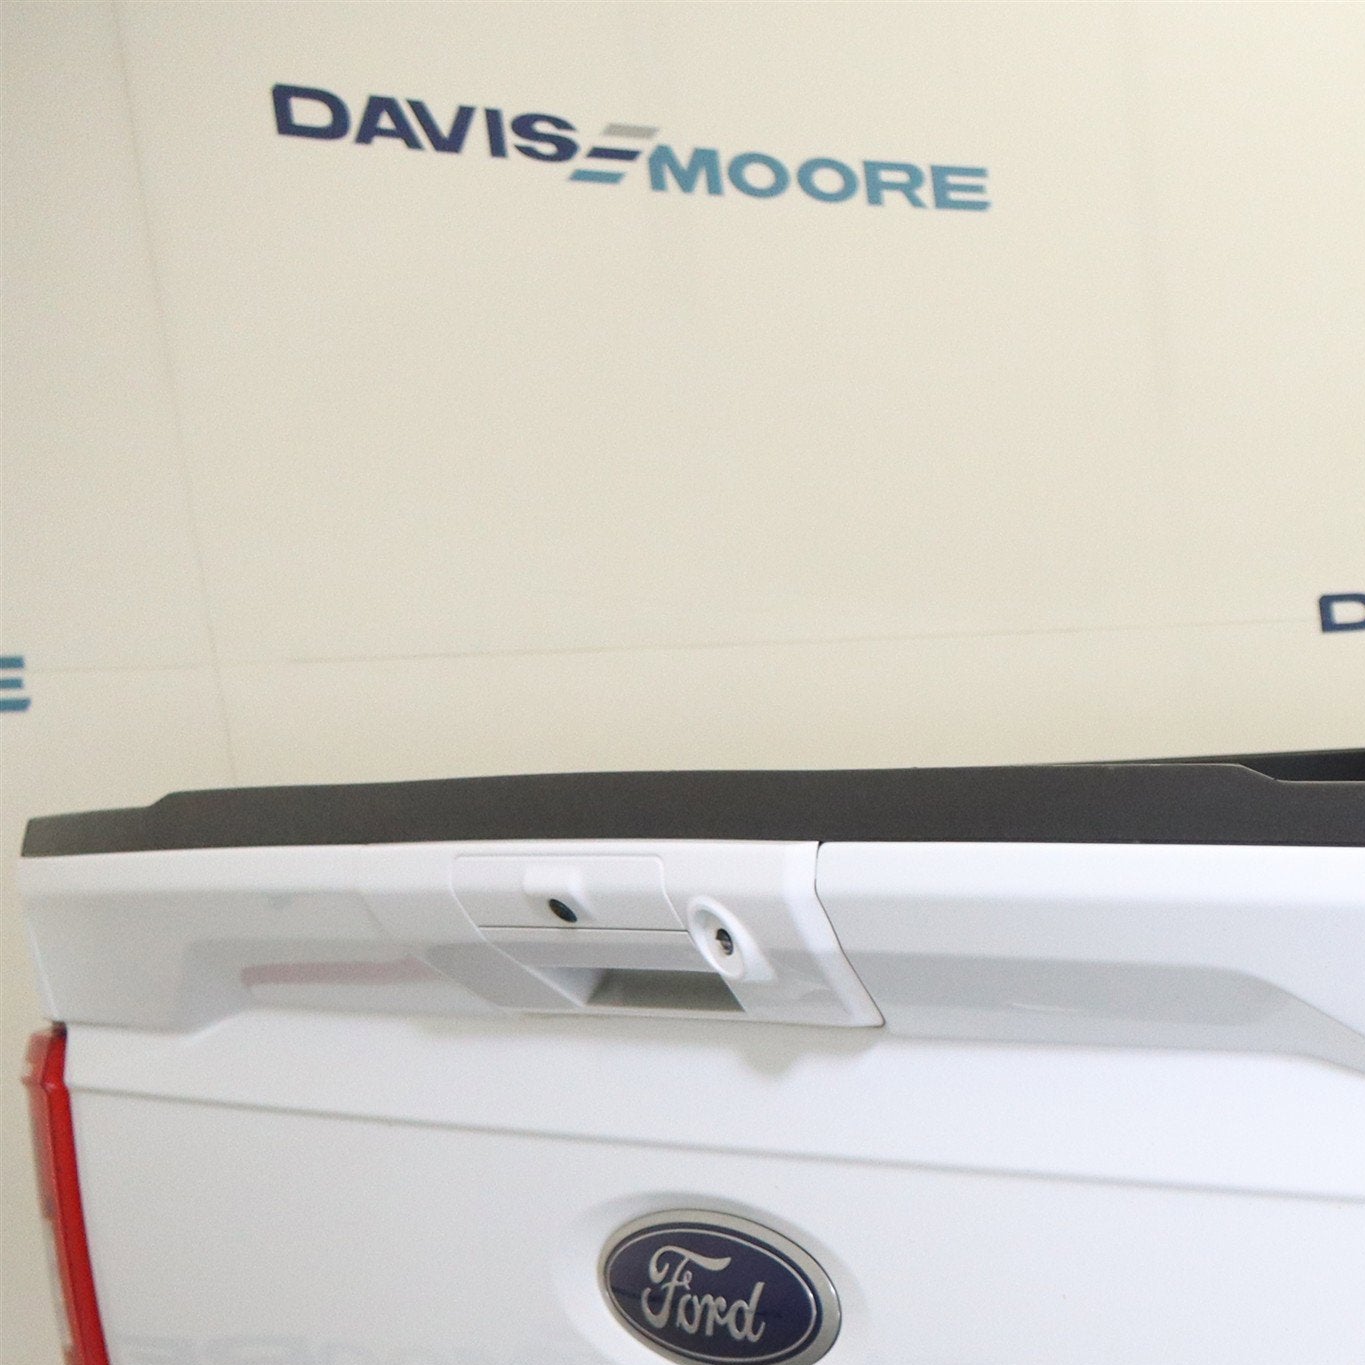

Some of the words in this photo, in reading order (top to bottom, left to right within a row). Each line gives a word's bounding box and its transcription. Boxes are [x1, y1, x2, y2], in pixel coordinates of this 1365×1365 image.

[270, 82, 580, 163] DAVIS
[647, 144, 993, 211] MOORE
[641, 1245, 766, 1343] Ford
